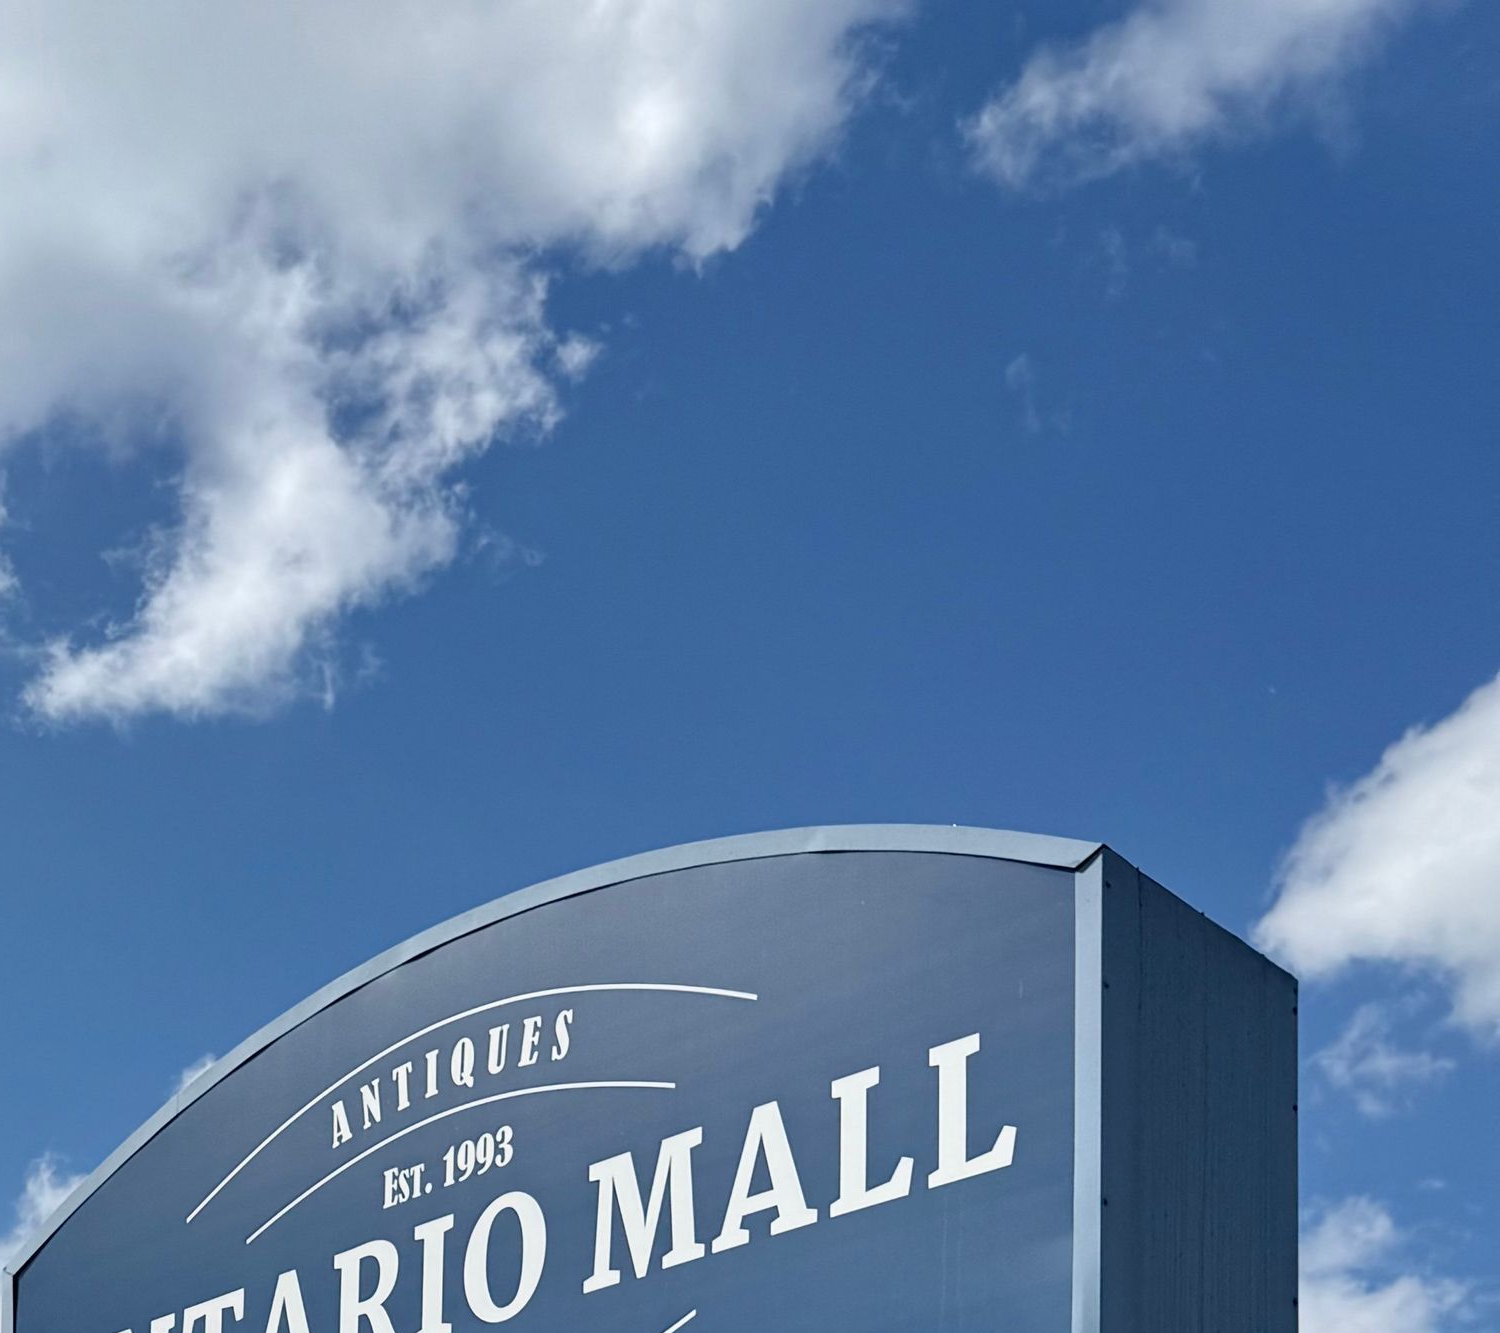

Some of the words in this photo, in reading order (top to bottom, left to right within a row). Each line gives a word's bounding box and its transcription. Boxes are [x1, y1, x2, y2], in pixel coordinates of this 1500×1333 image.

[330, 1008, 575, 1149] ANTIQUES
[442, 1125, 515, 1188] 1993
[581, 1032, 1018, 1295] MALL
